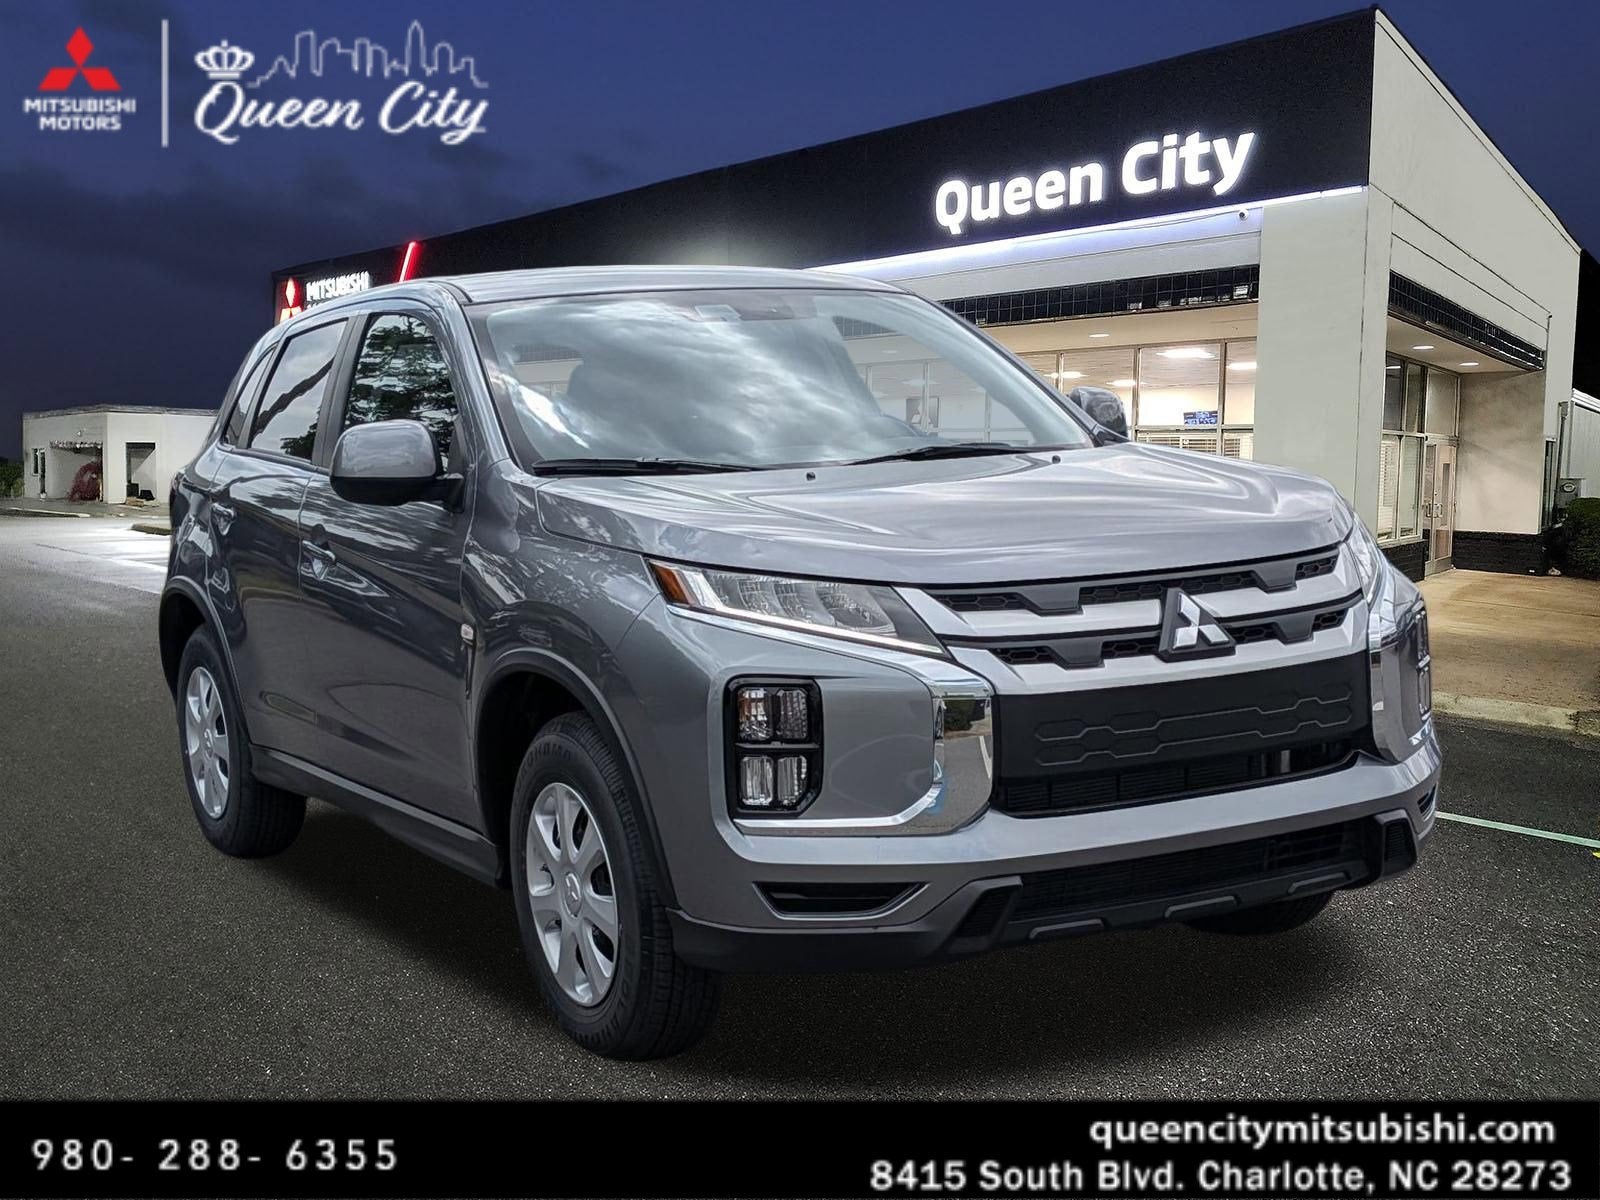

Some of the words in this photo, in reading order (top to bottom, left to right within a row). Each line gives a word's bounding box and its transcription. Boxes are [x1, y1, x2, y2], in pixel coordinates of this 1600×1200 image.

[935, 162, 1104, 235] Queen
[1121, 131, 1256, 196] City
[306, 271, 370, 302] MITSUBISHI
